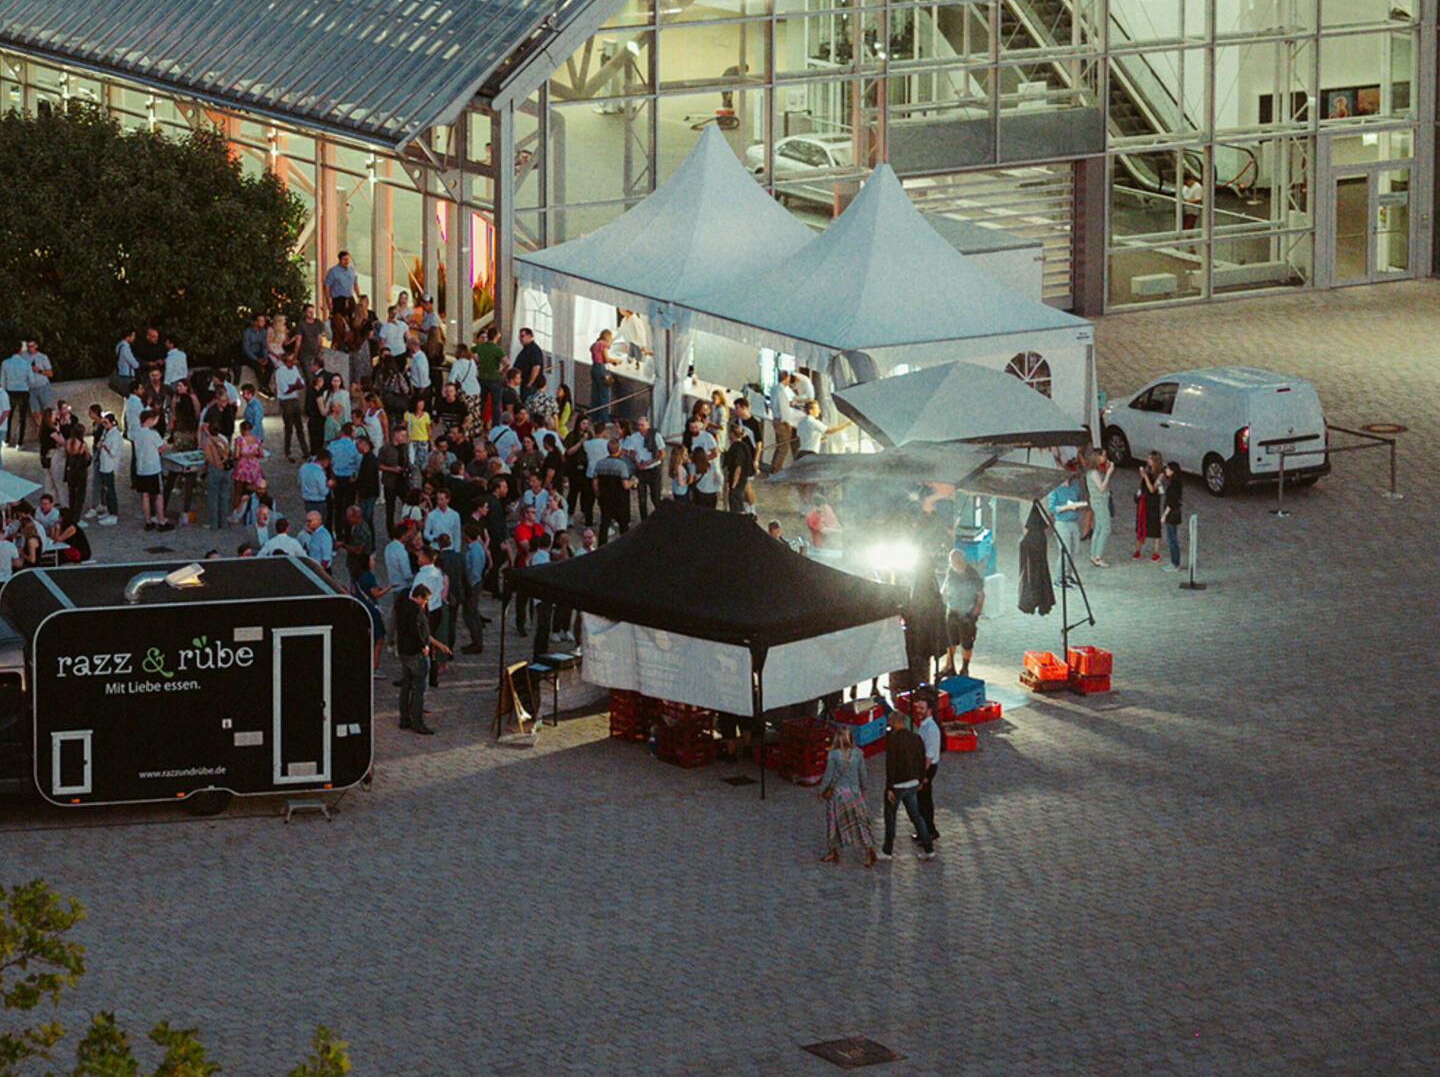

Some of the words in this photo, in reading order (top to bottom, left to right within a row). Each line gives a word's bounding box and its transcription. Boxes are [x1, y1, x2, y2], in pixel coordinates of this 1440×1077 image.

[56, 653, 133, 677] razz
[141, 647, 174, 678] &
[178, 635, 254, 671] rübe
[105, 682, 125, 694] Mit
[128, 680, 161, 694] Liebe
[164, 680, 201, 692] essen.
